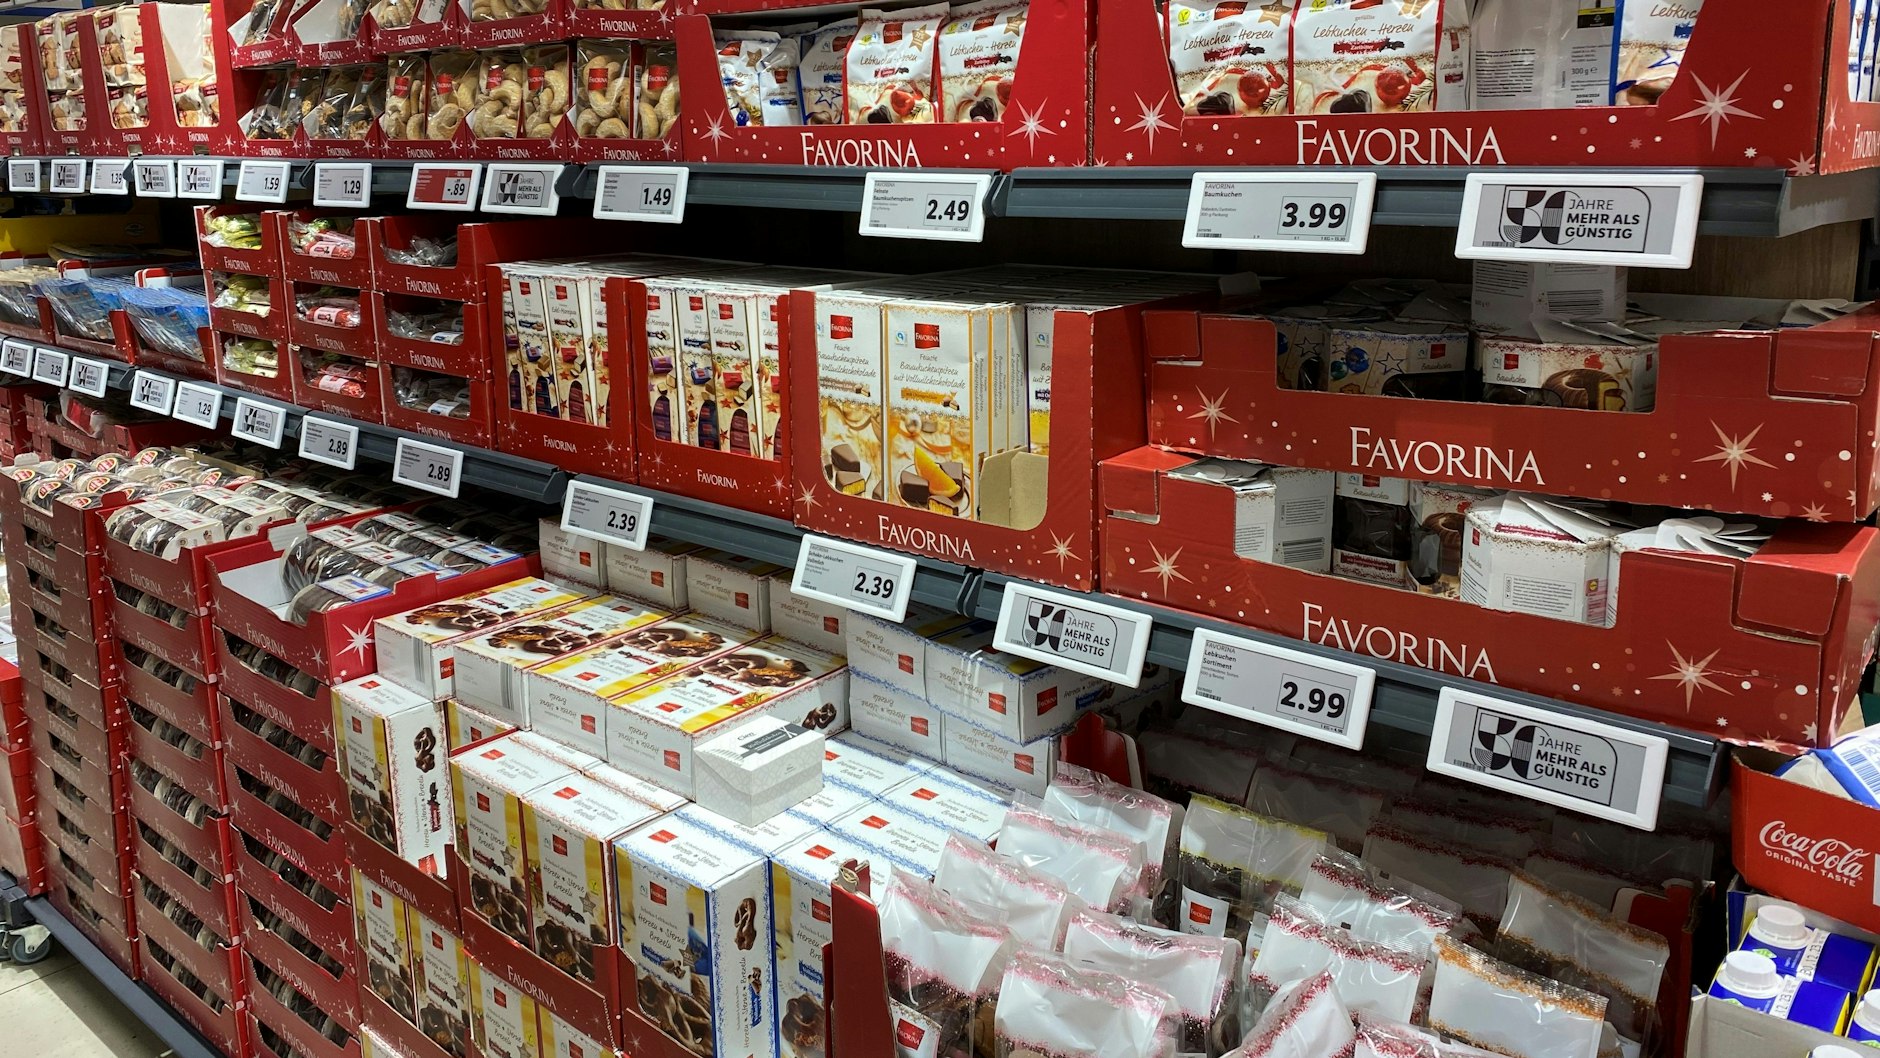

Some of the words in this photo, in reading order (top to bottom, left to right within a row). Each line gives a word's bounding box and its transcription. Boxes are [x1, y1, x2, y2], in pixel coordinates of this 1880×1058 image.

[491, 28, 523, 40] FAVORINA
[600, 18, 637, 32] FAVORINA
[1314, 24, 1367, 38] Lebkuchen
[1379, 23, 1414, 34] Herzen
[398, 35, 426, 46] FAVORINA
[990, 40, 1016, 50] Herzen
[1184, 31, 1230, 50] Lebkuchen
[1239, 29, 1273, 40] Herzen
[498, 146, 530, 158] FAVORINA
[800, 132, 922, 167] FAVORINA
[1295, 120, 1507, 166] FAVORINA
[406, 147, 435, 158] FAVORINA
[603, 147, 640, 160] FAVORINA
[112, 172, 122, 184] 1.39
[264, 177, 280, 190] 1.59
[344, 180, 360, 194] 1.29
[517, 192, 538, 200] GÜNSTIG
[644, 188, 672, 206] 1.49
[1569, 198, 1614, 211] JAHRE
[926, 200, 969, 221] 2.49
[1282, 202, 1346, 228] 3.99
[1566, 213, 1612, 224] MEHR
[1612, 214, 1640, 225] ALS
[1565, 224, 1633, 239] GÜNSTIG
[224, 256, 250, 272] FAVORINA
[310, 266, 340, 283] FAVORINA
[406, 276, 441, 295] FAVORINA
[832, 324, 852, 332] FAVORINA
[915, 332, 940, 342] FAVORINA
[315, 334, 345, 352] FAVORINA
[410, 350, 445, 370] FAVORINA
[51, 364, 62, 376] 3.29
[198, 402, 212, 416] 1.29
[328, 438, 348, 455] 2.89
[543, 434, 578, 454] FAVORINA
[1350, 426, 1546, 486] FAVORINA
[428, 464, 450, 482] 2.89
[697, 468, 738, 490] FAVORINA
[608, 510, 636, 532] 2.39
[878, 515, 976, 561] FAVORINA
[854, 572, 894, 598] 2.39
[1067, 616, 1095, 632] JAHRE
[246, 622, 287, 660] FAVORINA
[1064, 628, 1092, 642] MEHR
[1093, 635, 1110, 646] ALS
[1302, 602, 1498, 683] FAVORINA
[1063, 639, 1104, 657] GÜNSTIG
[1204, 650, 1236, 662] Lebkuchen
[1206, 642, 1235, 654] FAVORINA
[1202, 658, 1232, 670] Sortiment
[1280, 681, 1346, 719] 2.99
[254, 692, 295, 731] FAVORINA
[1538, 736, 1582, 756] JAHRE
[1536, 750, 1579, 769] MEHR
[1580, 761, 1607, 776] ALS
[259, 764, 300, 802] FAVORINA
[1534, 764, 1599, 789] GÜNSTIG
[266, 829, 308, 870] FAVORINA
[1758, 820, 1870, 880] Coca-Cola
[1765, 849, 1817, 874] ORIGINAL
[1820, 868, 1856, 888] TASTE
[380, 869, 418, 906] FAVORINA
[270, 894, 310, 936] FAVORINA
[1190, 908, 1211, 920] FAVORINA
[277, 958, 318, 1003] FAVORINA
[507, 964, 558, 1010] FAVORINA
